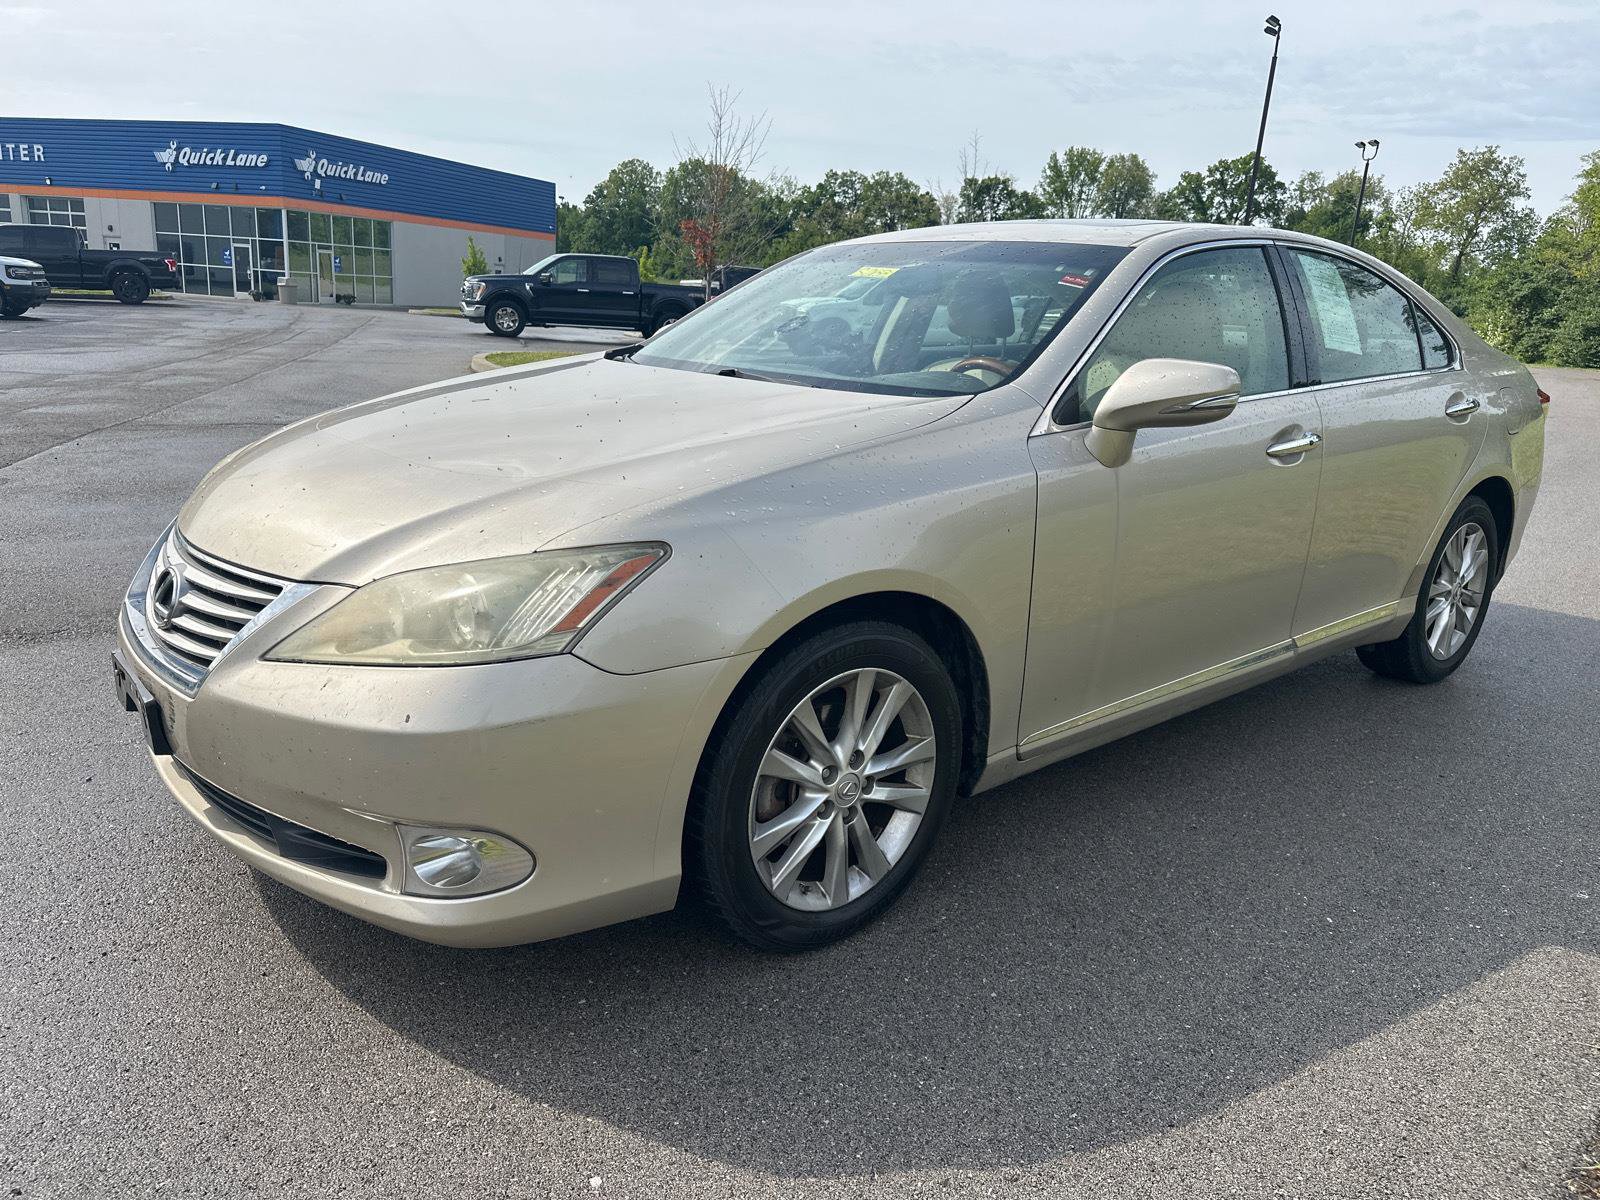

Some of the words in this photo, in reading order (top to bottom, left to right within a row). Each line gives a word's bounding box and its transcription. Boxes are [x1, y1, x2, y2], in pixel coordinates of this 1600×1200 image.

[0, 143, 45, 162] TER
[178, 147, 226, 166] Quick
[225, 149, 268, 167] Lane
[317, 158, 357, 180] Quick
[356, 165, 389, 185] Lane
